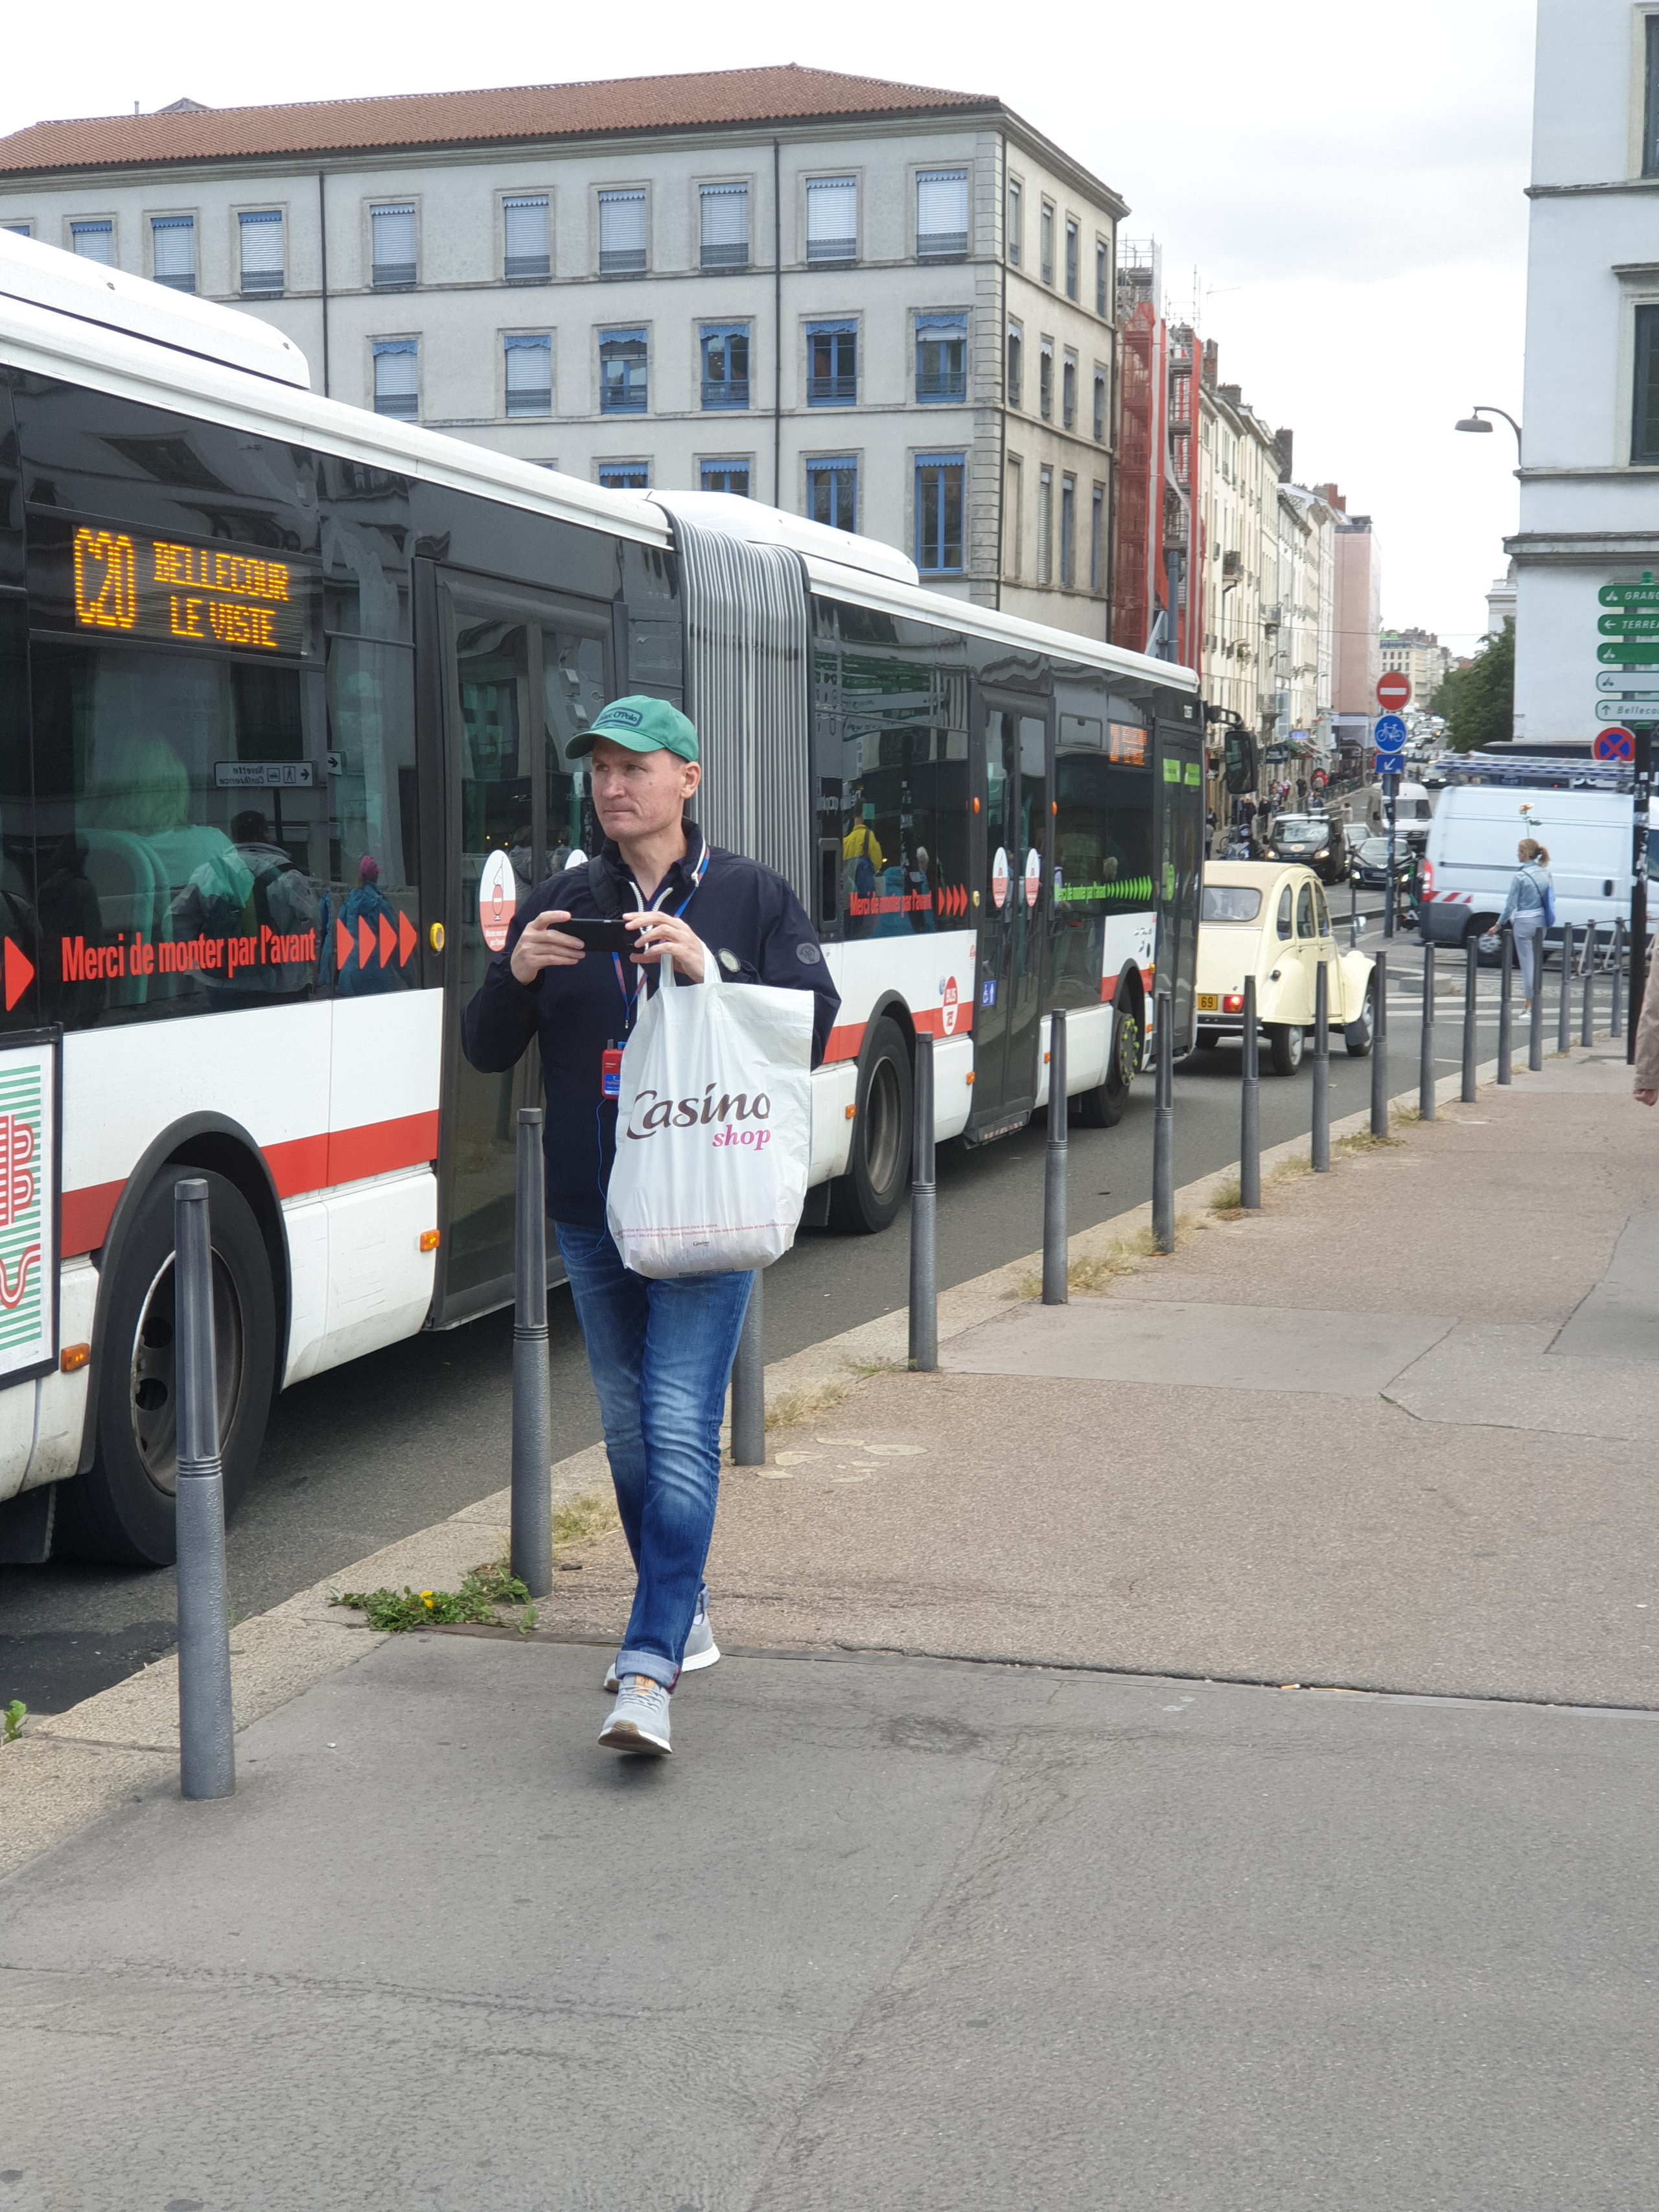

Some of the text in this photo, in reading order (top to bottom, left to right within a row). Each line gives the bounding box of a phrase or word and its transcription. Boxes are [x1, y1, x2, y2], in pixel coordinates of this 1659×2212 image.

[74, 527, 134, 629] C20
[153, 542, 289, 601] BELLECOUR
[170, 596, 278, 647] LE VISTE
[1617, 706, 1659, 715] Belleco
[62, 924, 316, 982] Merci de monter par l'avant
[1201, 996, 1214, 1008] 69
[626, 1082, 771, 1140] Casino
[712, 1124, 771, 1151] shop
